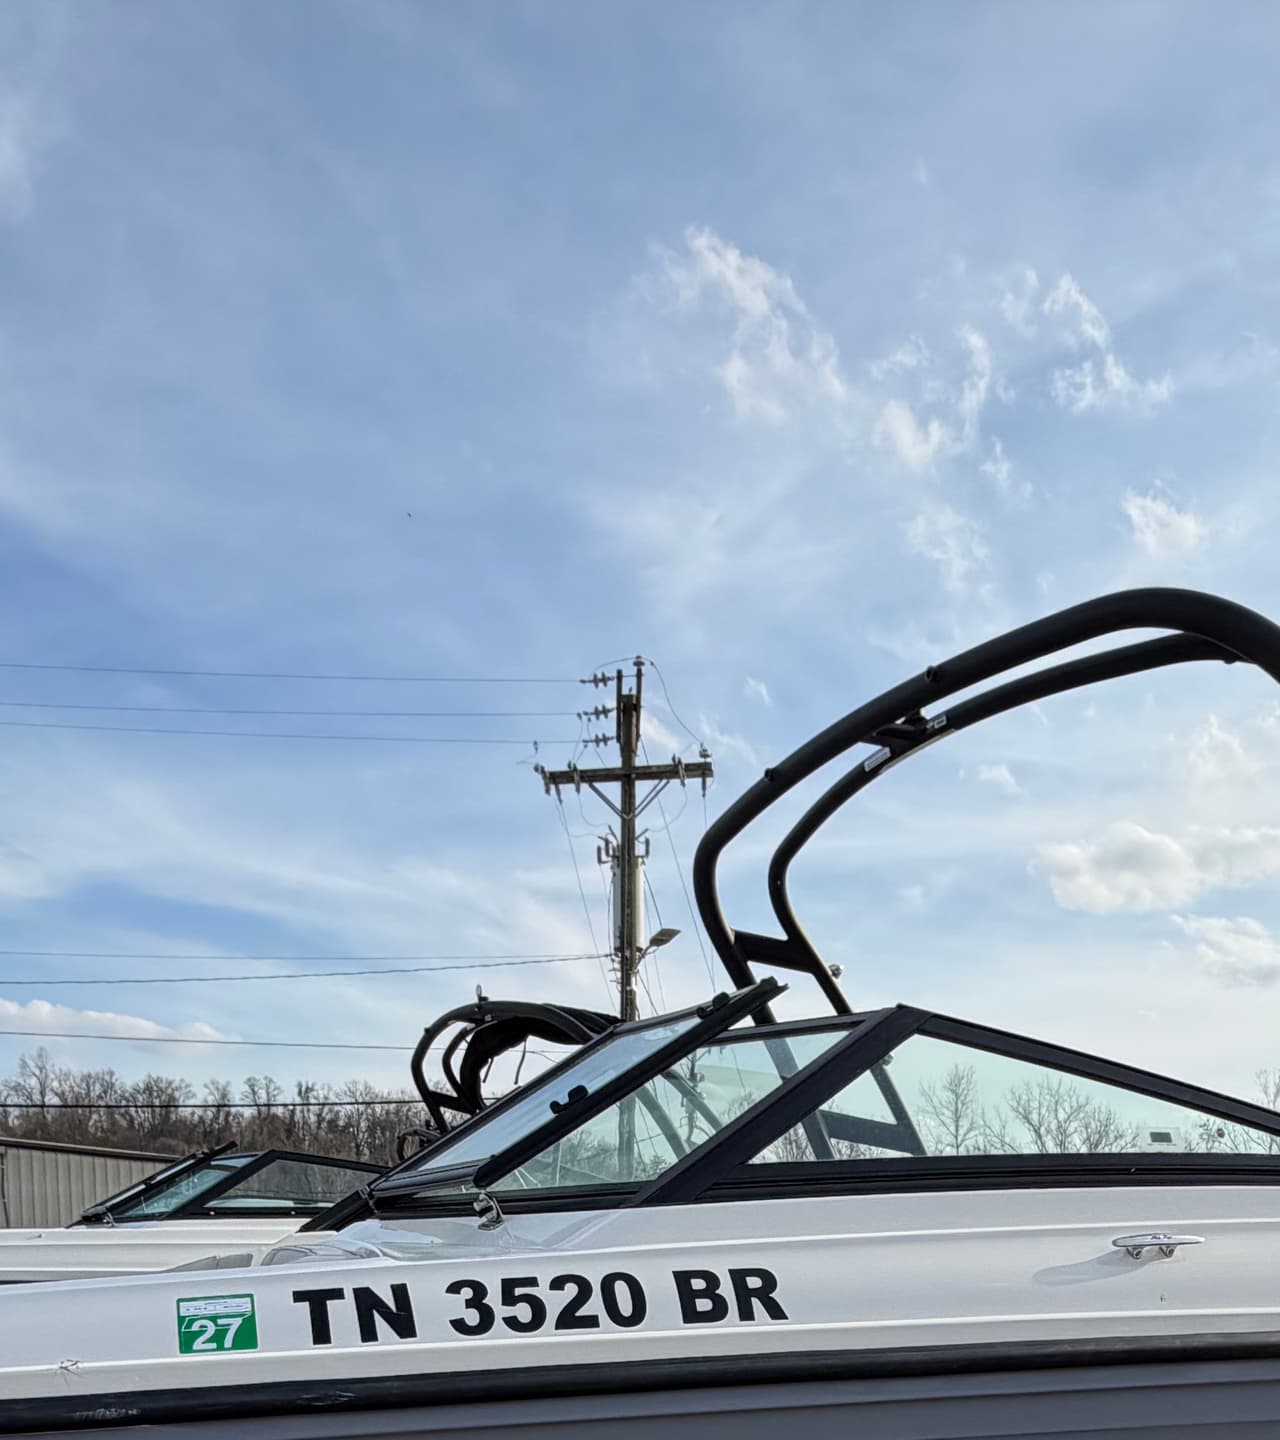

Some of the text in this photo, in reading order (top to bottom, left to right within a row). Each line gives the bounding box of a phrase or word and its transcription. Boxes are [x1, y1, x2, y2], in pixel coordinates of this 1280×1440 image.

[292, 1266, 790, 1345] TN 3520 BR
[191, 1317, 243, 1351] 27
